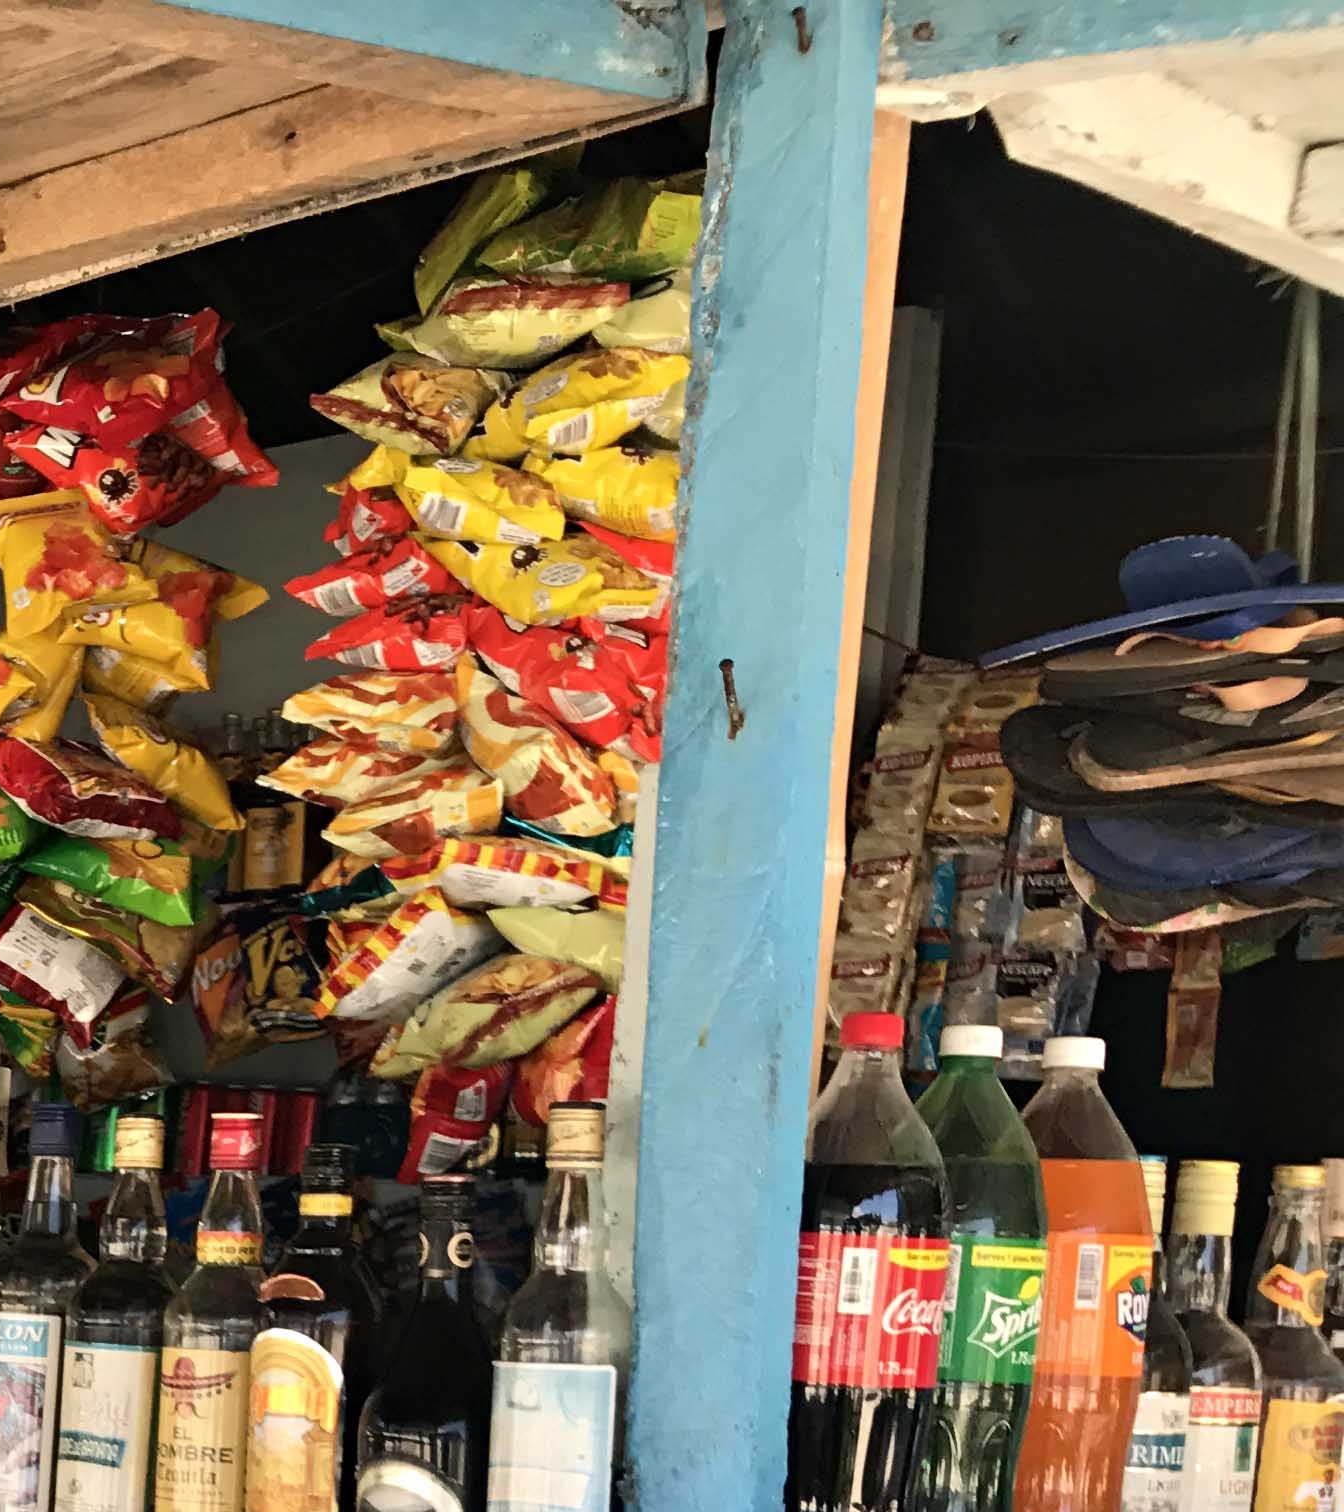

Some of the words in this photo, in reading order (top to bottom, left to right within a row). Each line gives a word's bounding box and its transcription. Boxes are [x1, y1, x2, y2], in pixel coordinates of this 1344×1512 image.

[1192, 1397, 1260, 1418] EMPER
[173, 1427, 193, 1441] EL
[158, 1443, 234, 1465] OMBRE
[1219, 1480, 1251, 1496] LIGH
